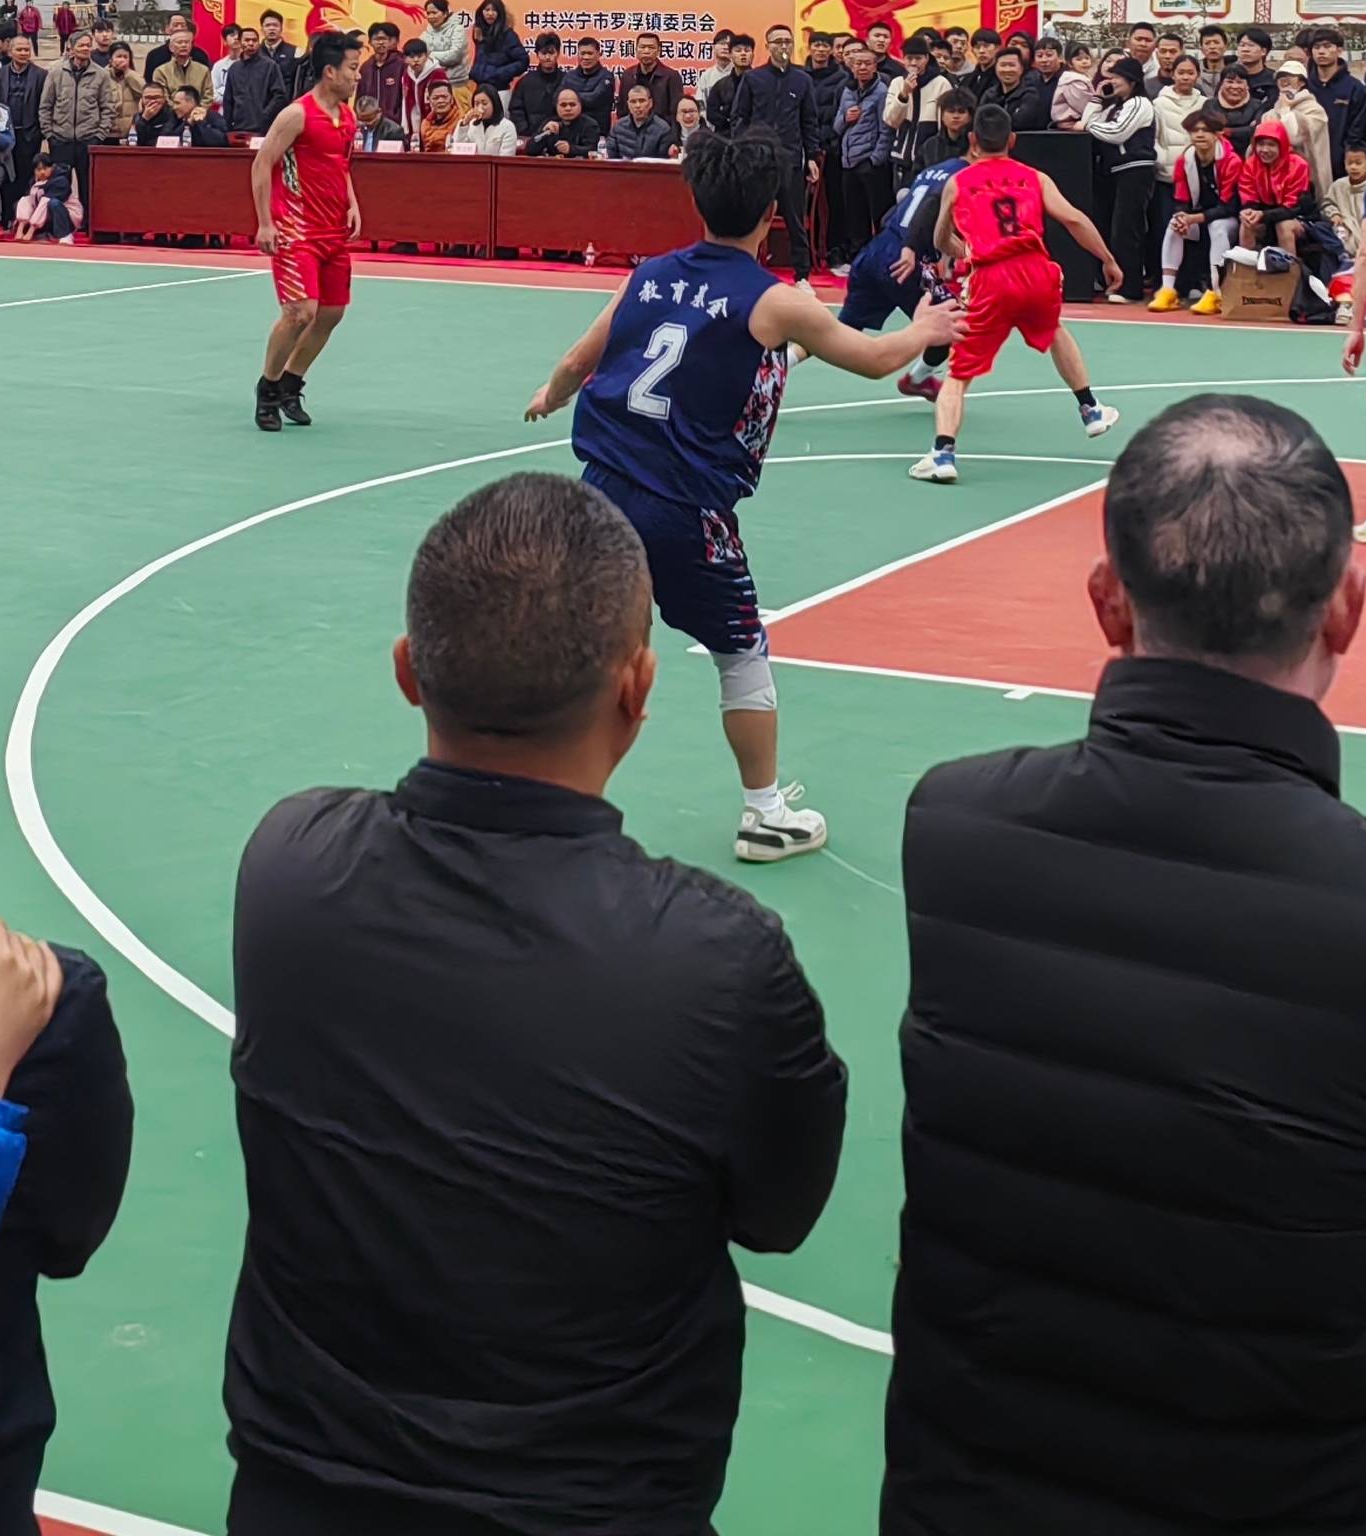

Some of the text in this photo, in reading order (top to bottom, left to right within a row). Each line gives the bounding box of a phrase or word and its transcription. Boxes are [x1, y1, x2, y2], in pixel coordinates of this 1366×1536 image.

[524, 12, 715, 32] 中共兴宁市罗浮镇委员会
[627, 322, 688, 420] 2
